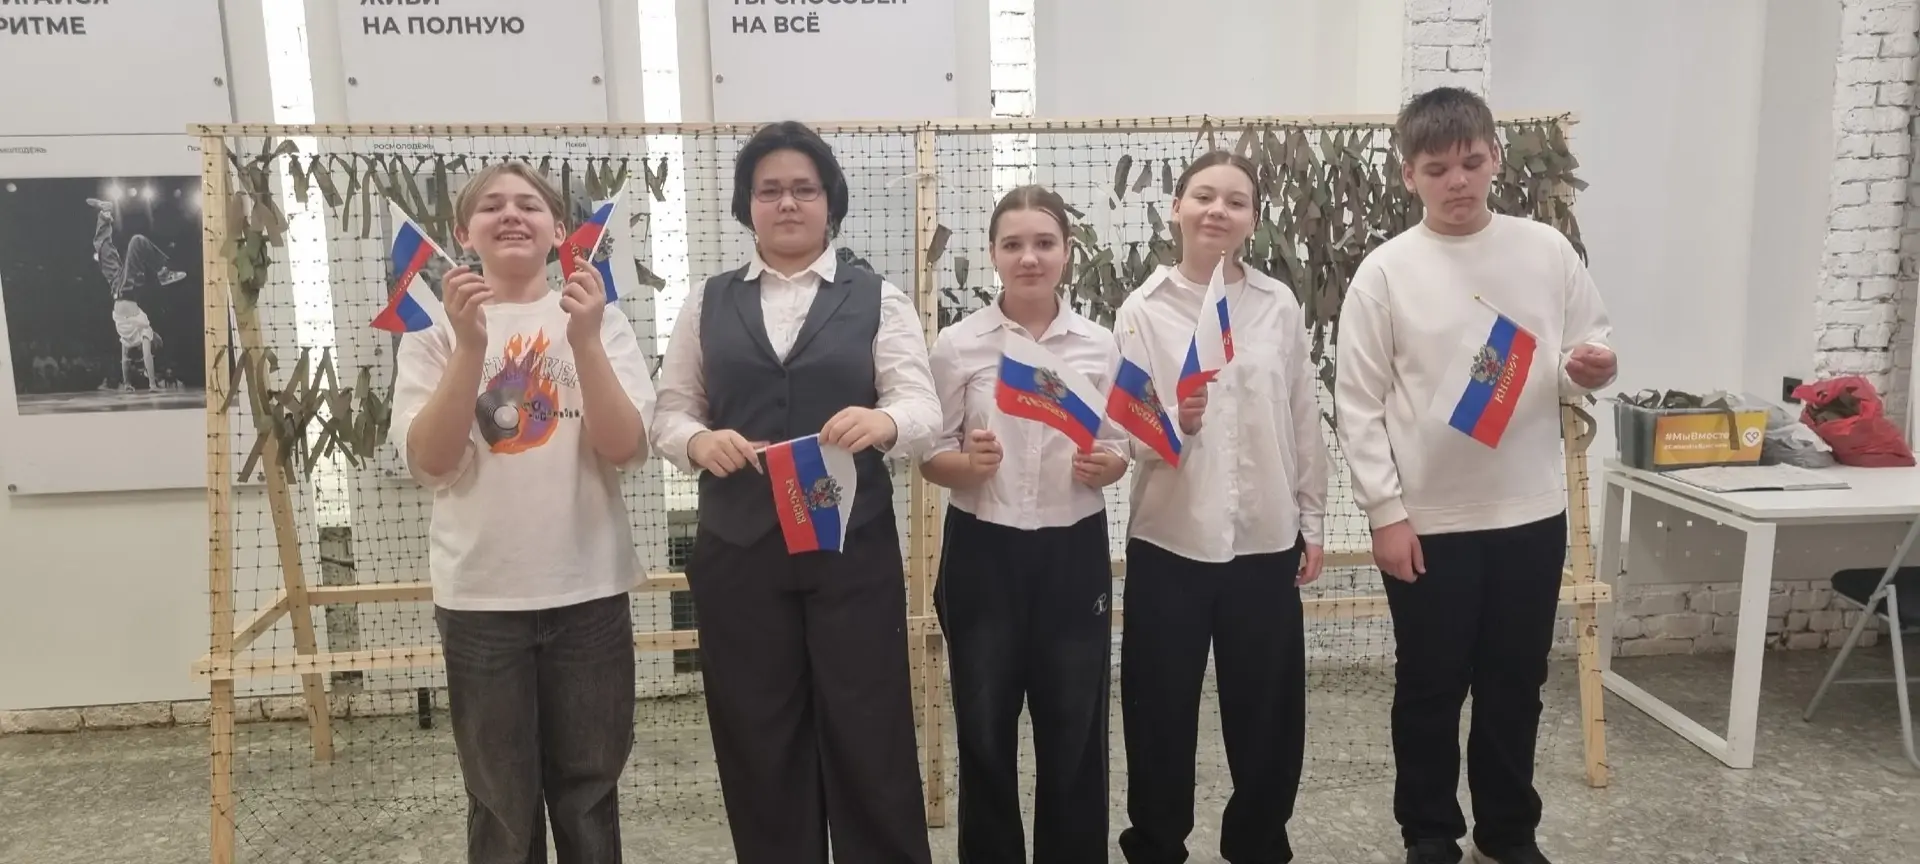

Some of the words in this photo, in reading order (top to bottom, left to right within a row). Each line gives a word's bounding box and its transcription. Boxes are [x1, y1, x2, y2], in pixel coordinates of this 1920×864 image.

[363, 16, 401, 34] НА
[408, 16, 525, 35] ПОЛНУЮ
[732, 16, 767, 33] НА
[774, 12, 820, 33] ВСЁ
